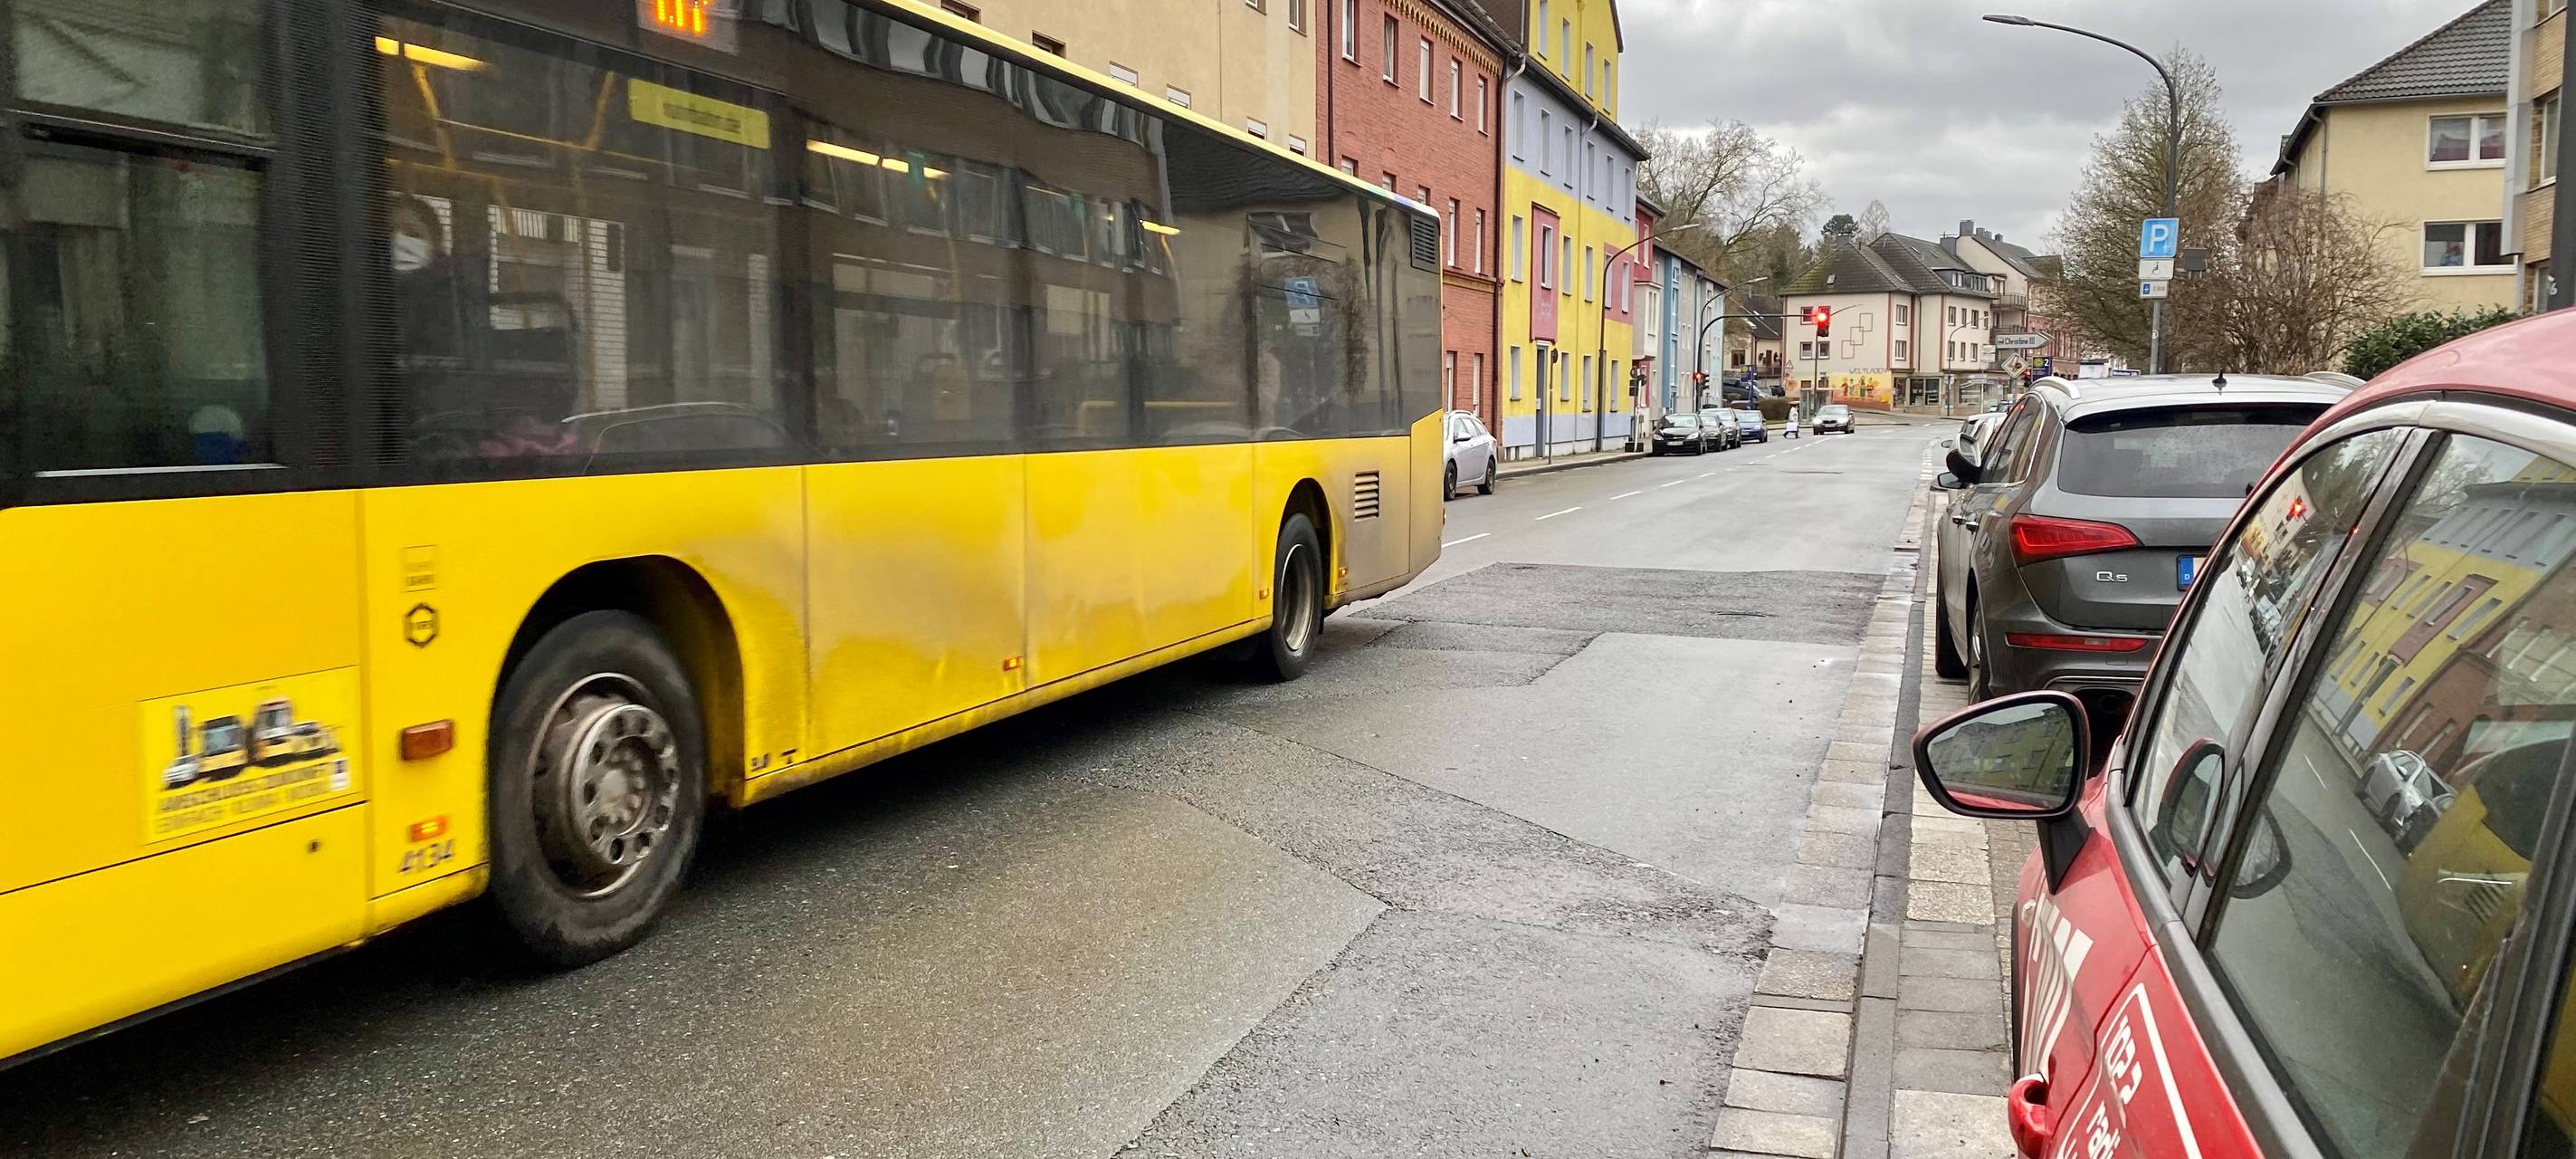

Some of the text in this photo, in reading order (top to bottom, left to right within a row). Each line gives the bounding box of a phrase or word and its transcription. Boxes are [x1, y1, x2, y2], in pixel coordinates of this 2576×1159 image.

[2149, 224, 2170, 254] P
[2044, 359, 2049, 367] 2
[2096, 570, 2128, 582] Q5
[398, 838, 453, 874] 4134
